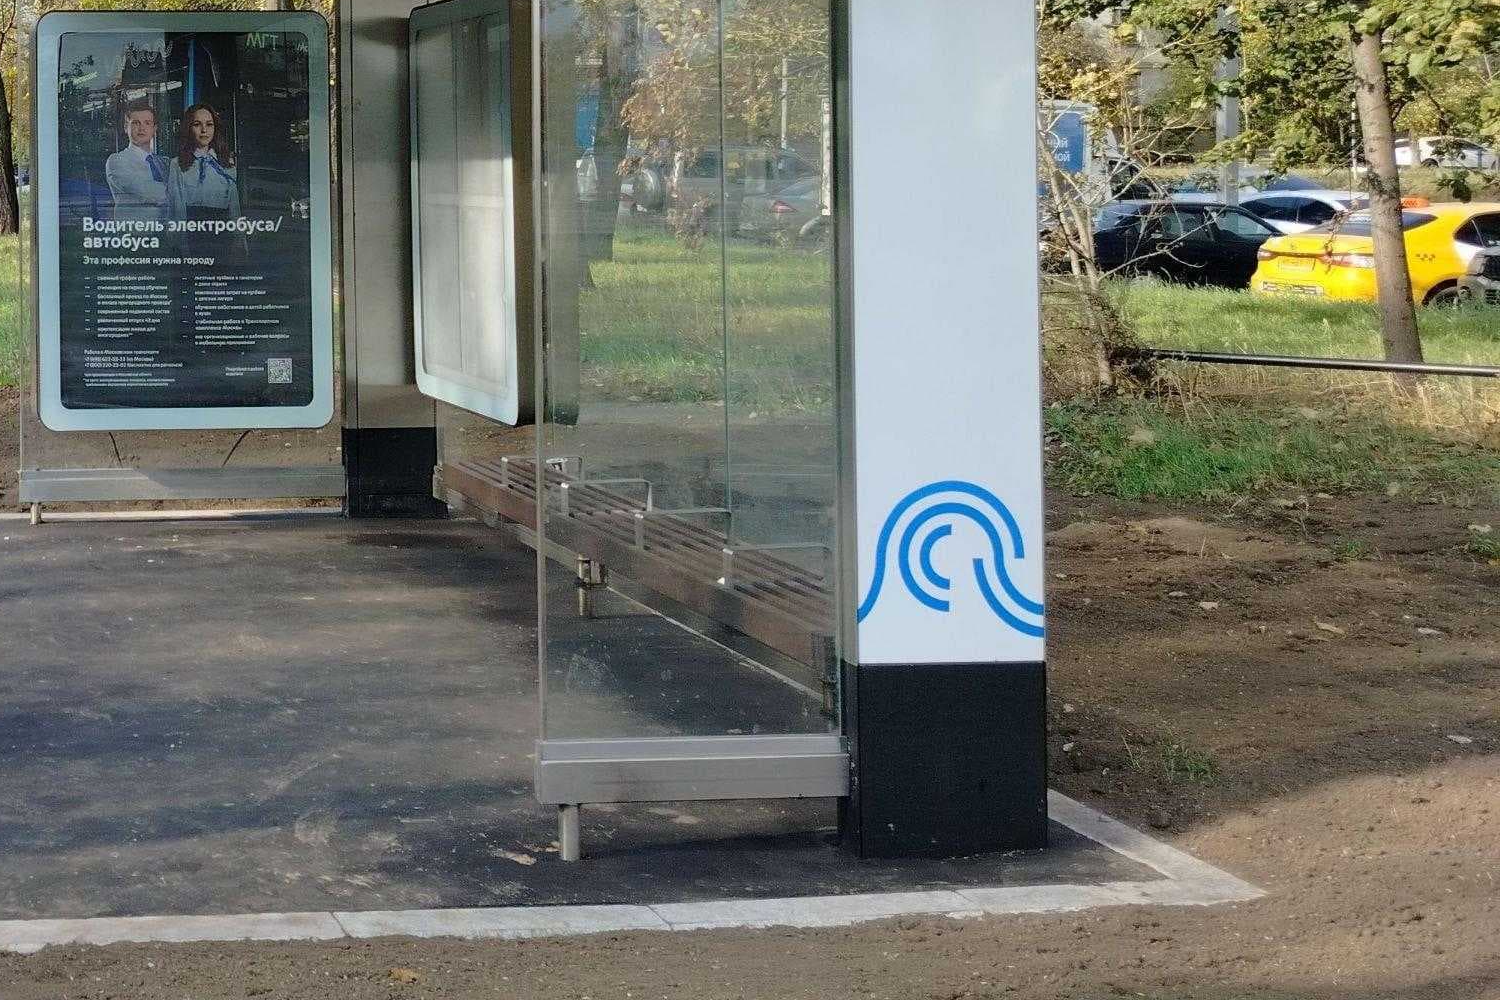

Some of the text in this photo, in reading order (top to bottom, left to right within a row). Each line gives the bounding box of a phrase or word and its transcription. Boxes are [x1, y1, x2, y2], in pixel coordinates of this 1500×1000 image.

[82, 216, 283, 235] Водитель электробуса/
[83, 234, 160, 251] автобуса
[82, 256, 215, 267] Эта профессия нужна городу
